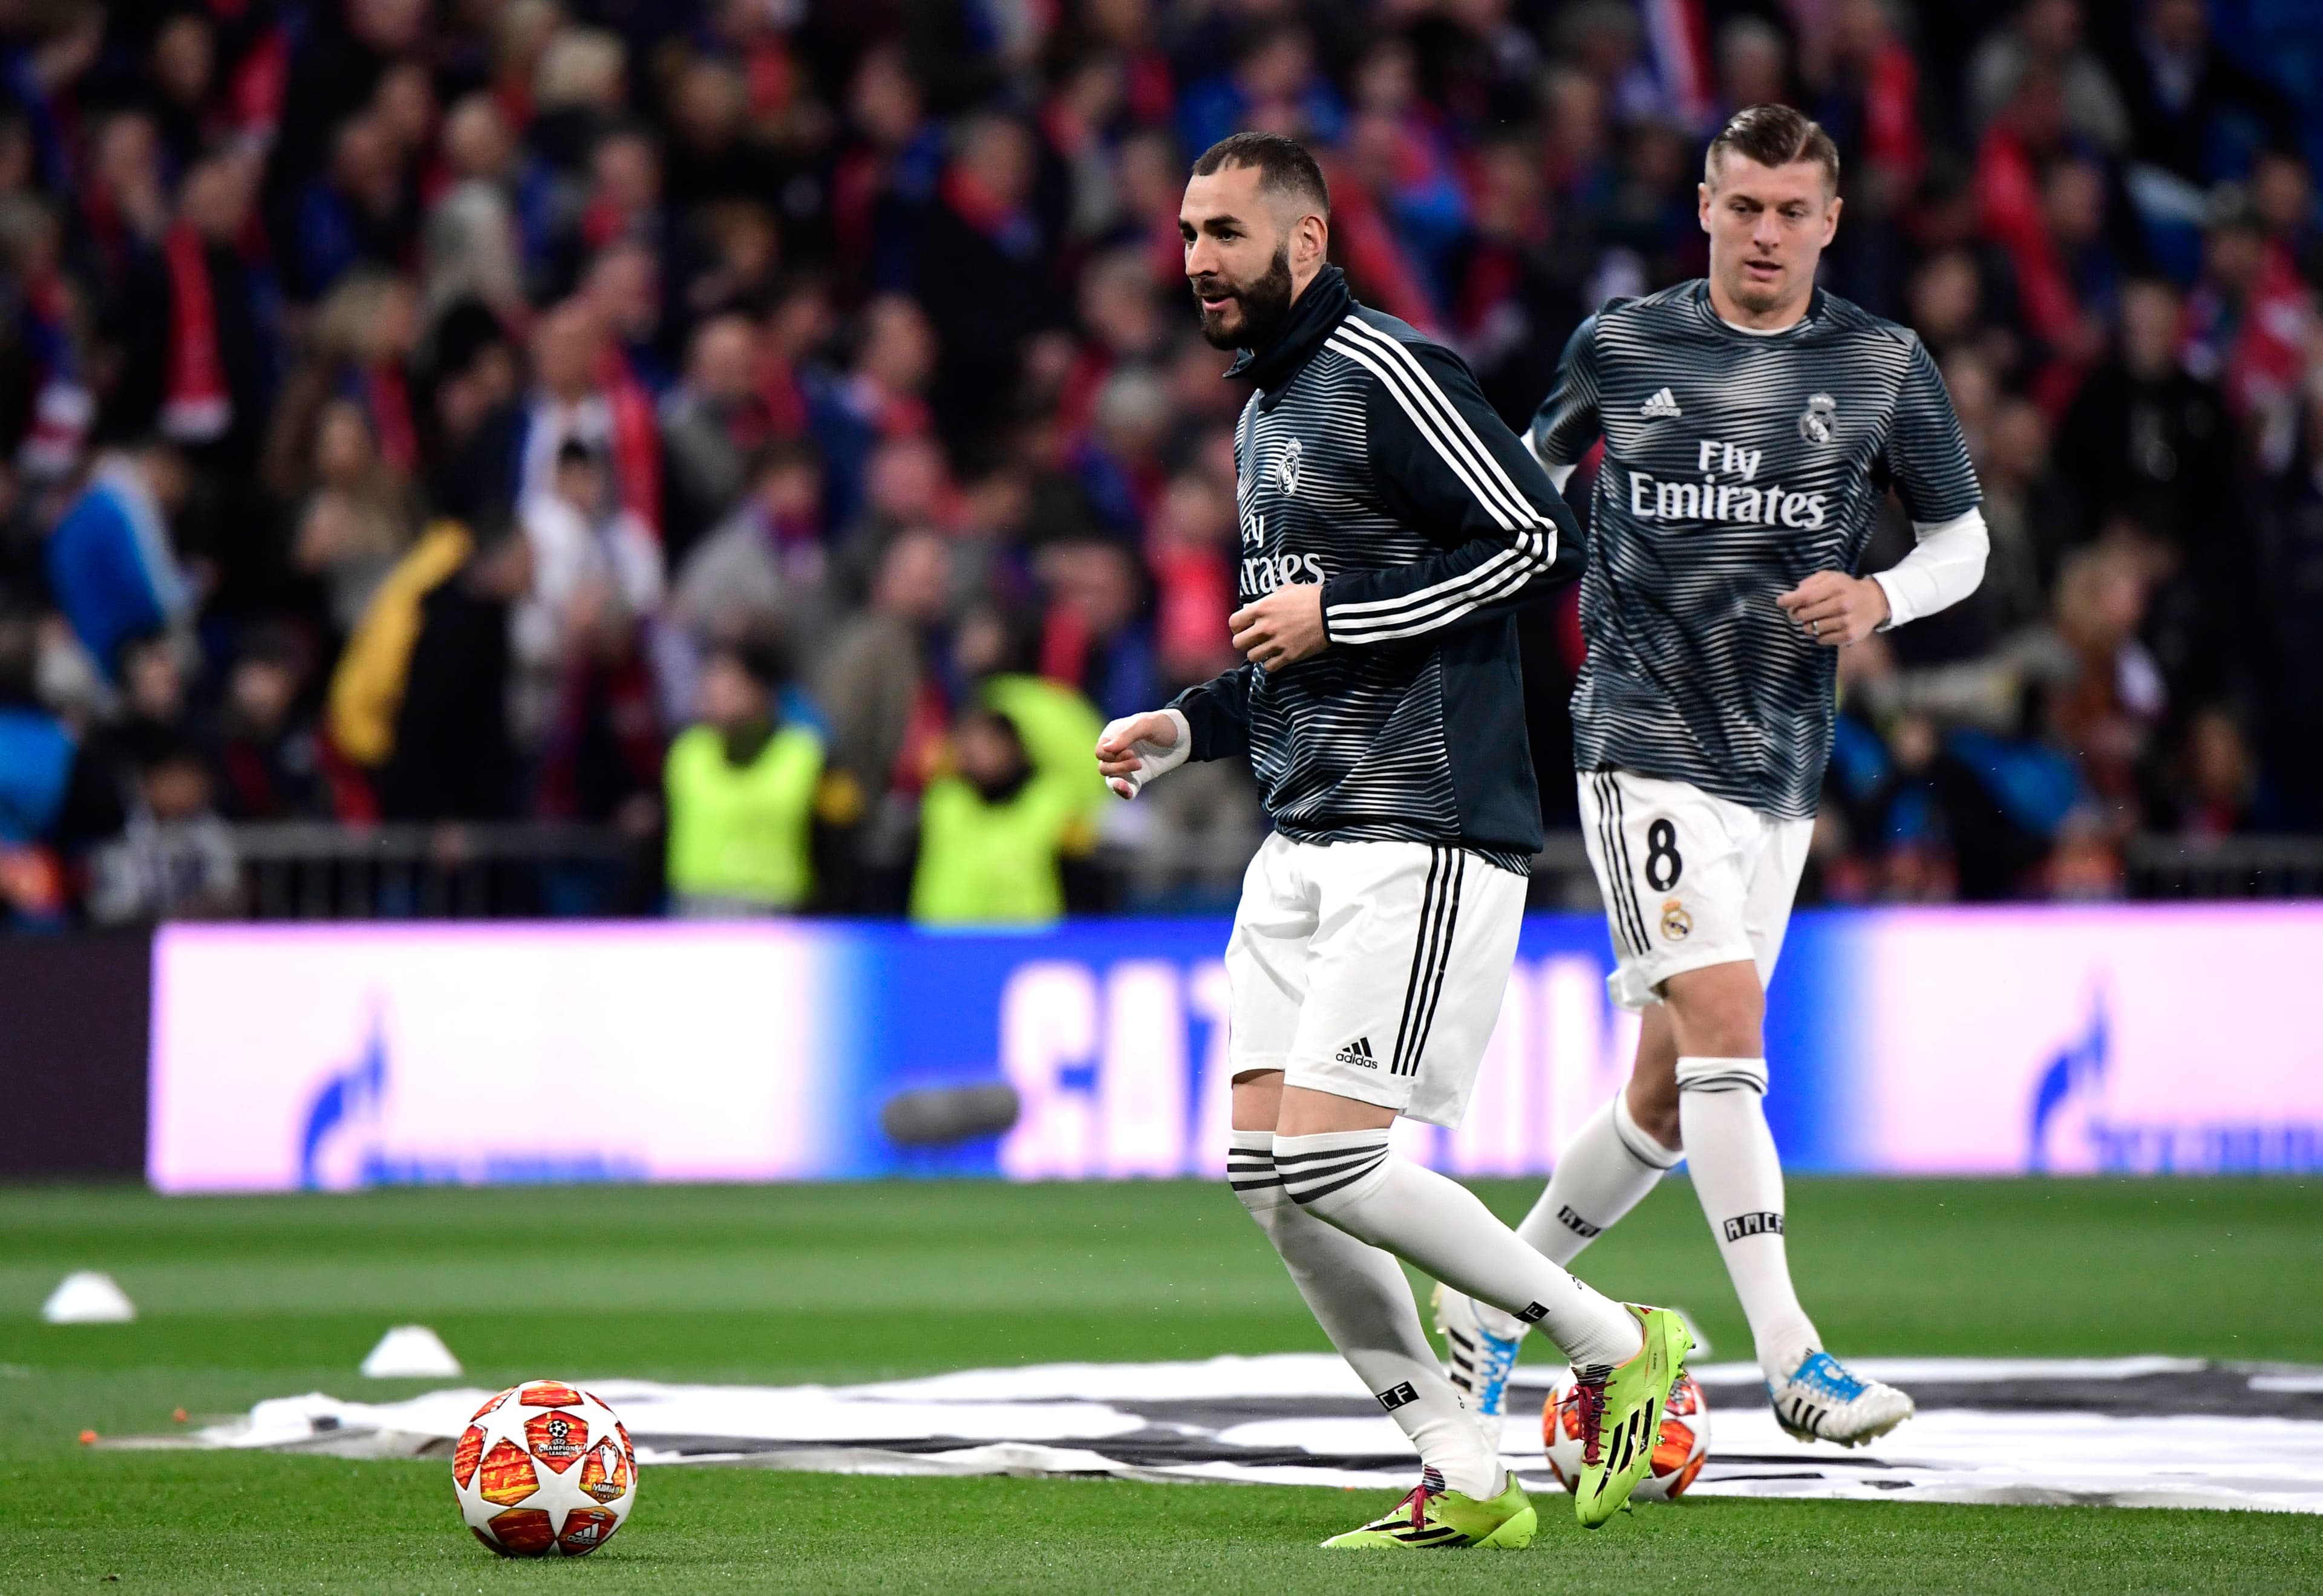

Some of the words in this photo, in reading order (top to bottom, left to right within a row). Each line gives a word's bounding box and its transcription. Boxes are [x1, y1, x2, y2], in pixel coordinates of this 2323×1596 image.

[1699, 440, 1761, 481] Fly
[1630, 472, 1826, 528] Emirates
[1646, 819, 1682, 891] 8
[1336, 1053, 1378, 1069] adidas
[1379, 1384, 1408, 1409] CF
